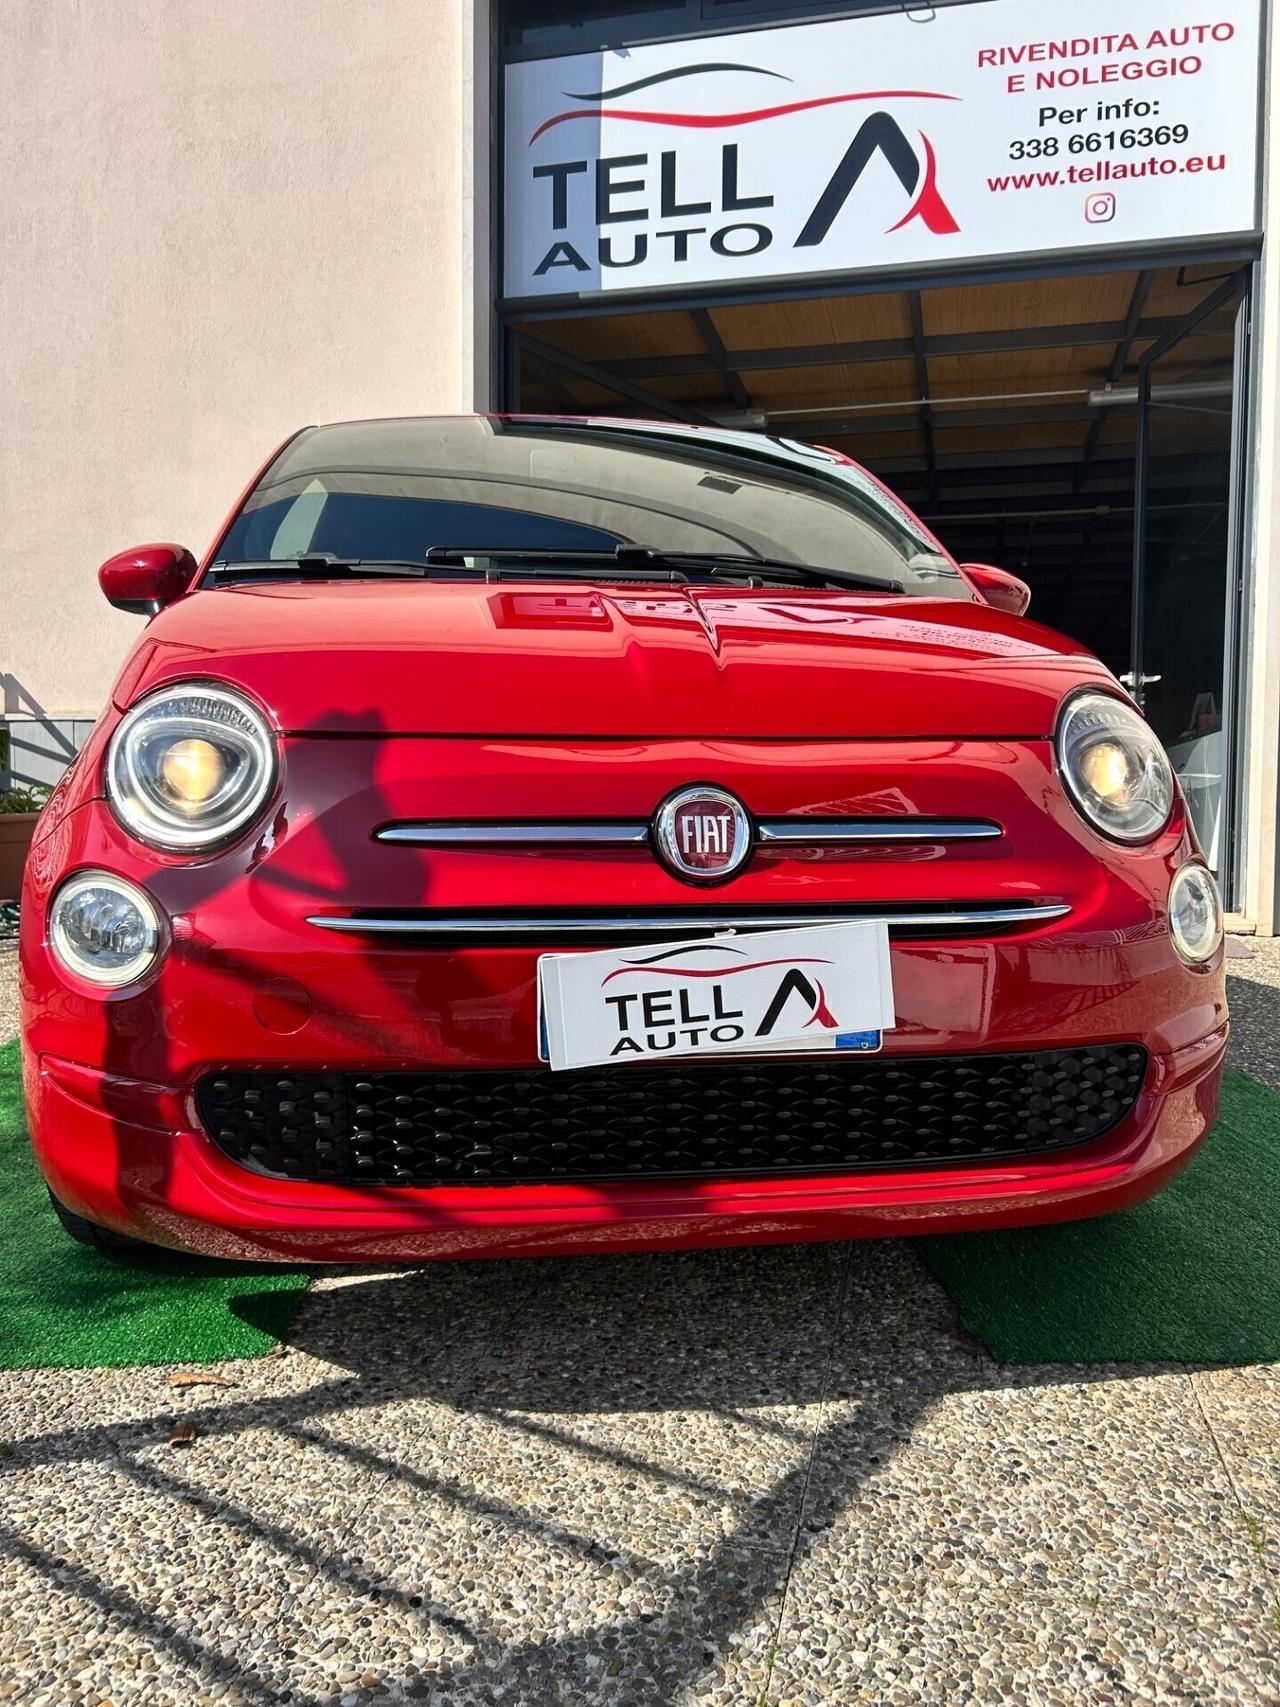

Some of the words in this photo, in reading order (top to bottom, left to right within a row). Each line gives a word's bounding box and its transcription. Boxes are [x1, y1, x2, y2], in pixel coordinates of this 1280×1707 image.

[978, 34, 1139, 68] RIVENDITA
[1146, 22, 1235, 49] AUTO
[1007, 74, 1025, 94] E
[1036, 55, 1202, 90] NOLEGGIO
[1038, 106, 1088, 127] Per
[1096, 97, 1160, 121] info:
[1008, 136, 1060, 160] 338
[1068, 123, 1190, 154] 6616369
[532, 143, 774, 231] TELL
[987, 154, 1227, 192] www.tellauto.eu
[532, 223, 773, 277] AUTO
[681, 815, 731, 854] FIAT
[605, 984, 744, 1031] TELL
[609, 1024, 745, 1057] AUTO
